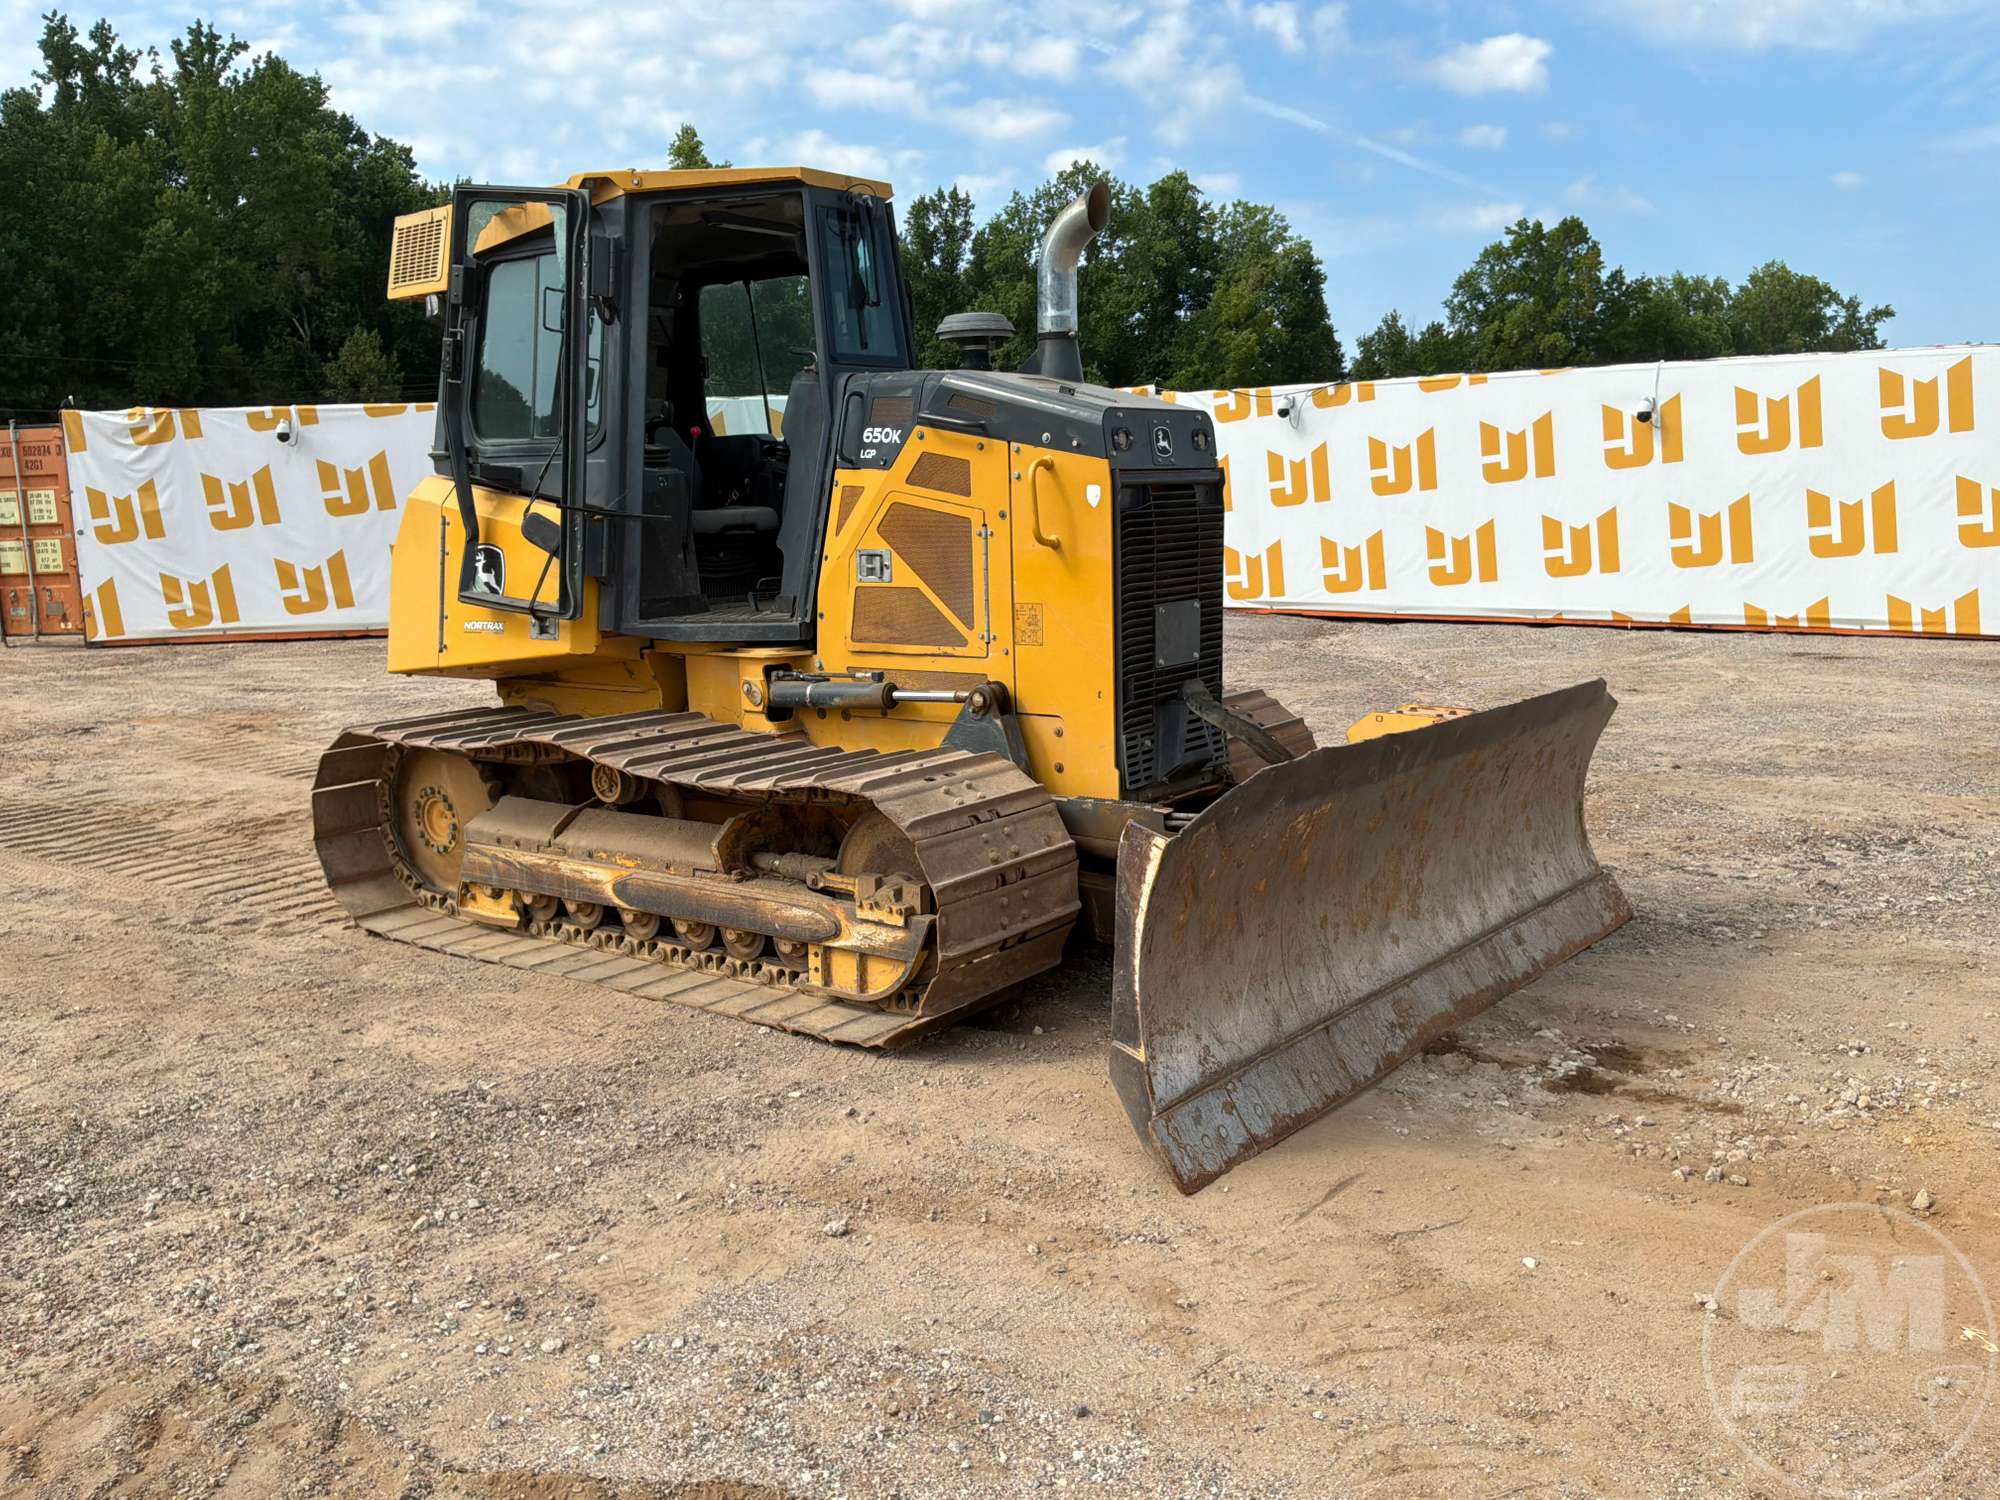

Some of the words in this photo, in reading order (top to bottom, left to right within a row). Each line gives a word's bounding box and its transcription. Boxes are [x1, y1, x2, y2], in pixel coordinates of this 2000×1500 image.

[863, 427, 902, 444] 650K
[860, 449, 877, 459] LGP
[464, 621, 505, 632] NORTRAX
